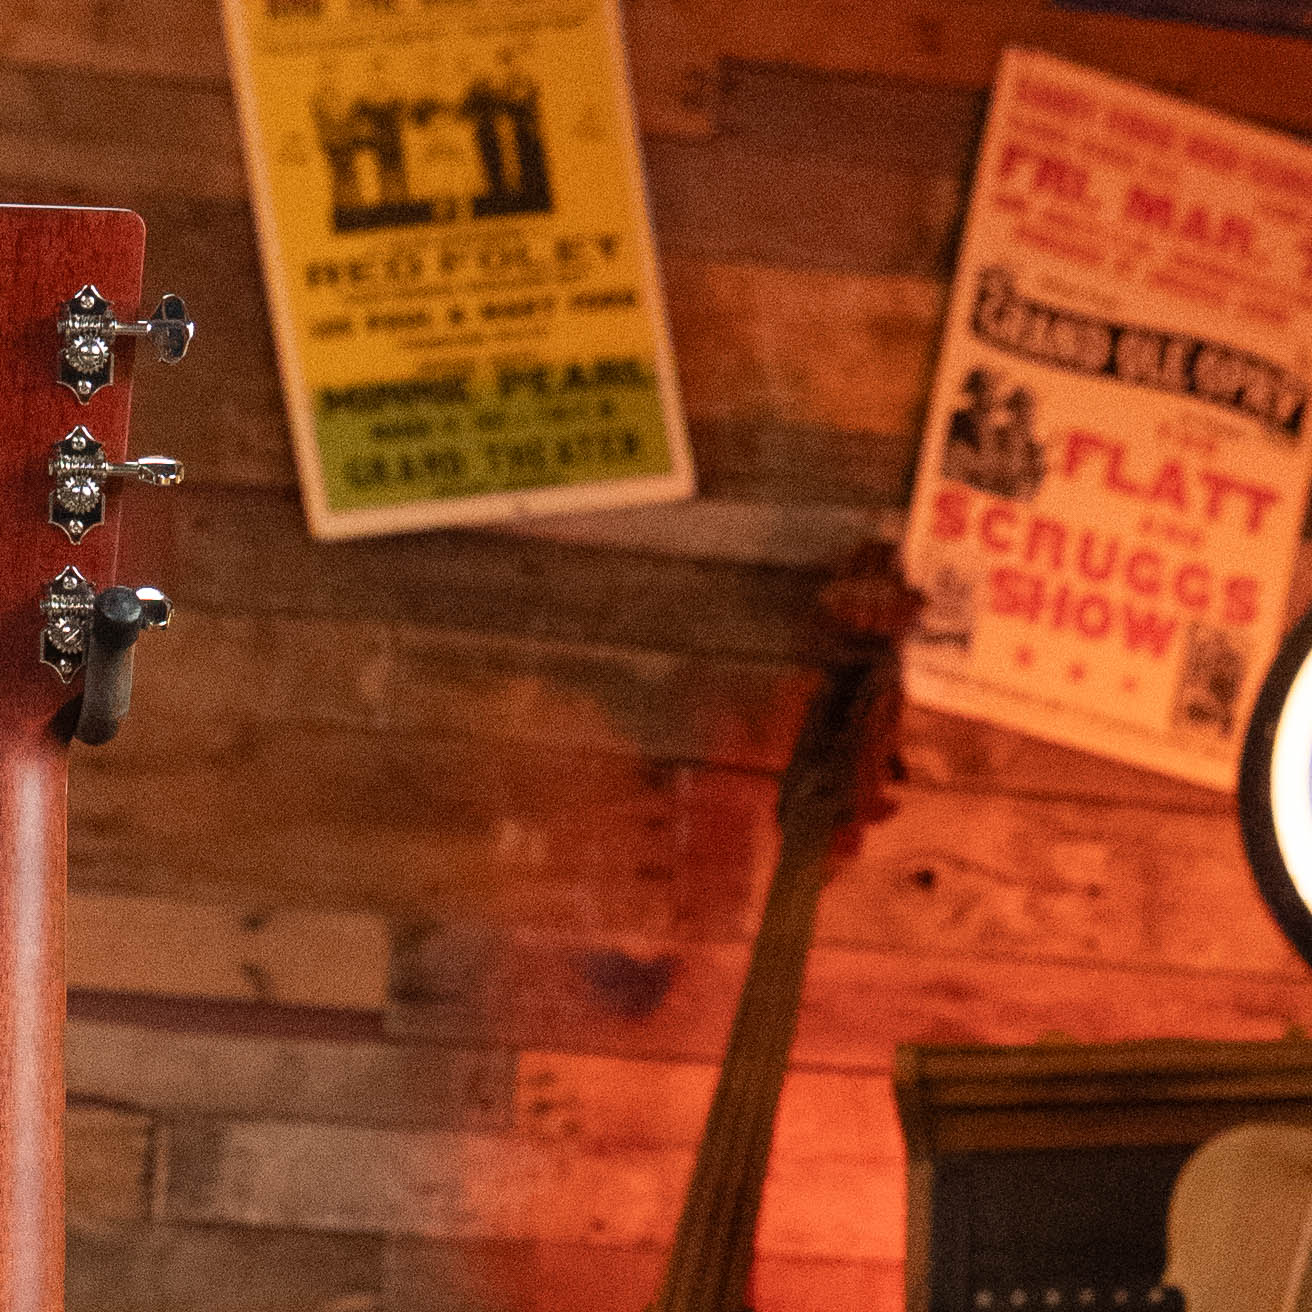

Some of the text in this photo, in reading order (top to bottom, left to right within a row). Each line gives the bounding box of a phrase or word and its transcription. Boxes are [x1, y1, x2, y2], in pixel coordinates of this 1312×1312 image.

[1061, 429, 1284, 536] FLATT
[928, 486, 1267, 629] SCRUGGS
[988, 564, 1179, 659] SHOW
